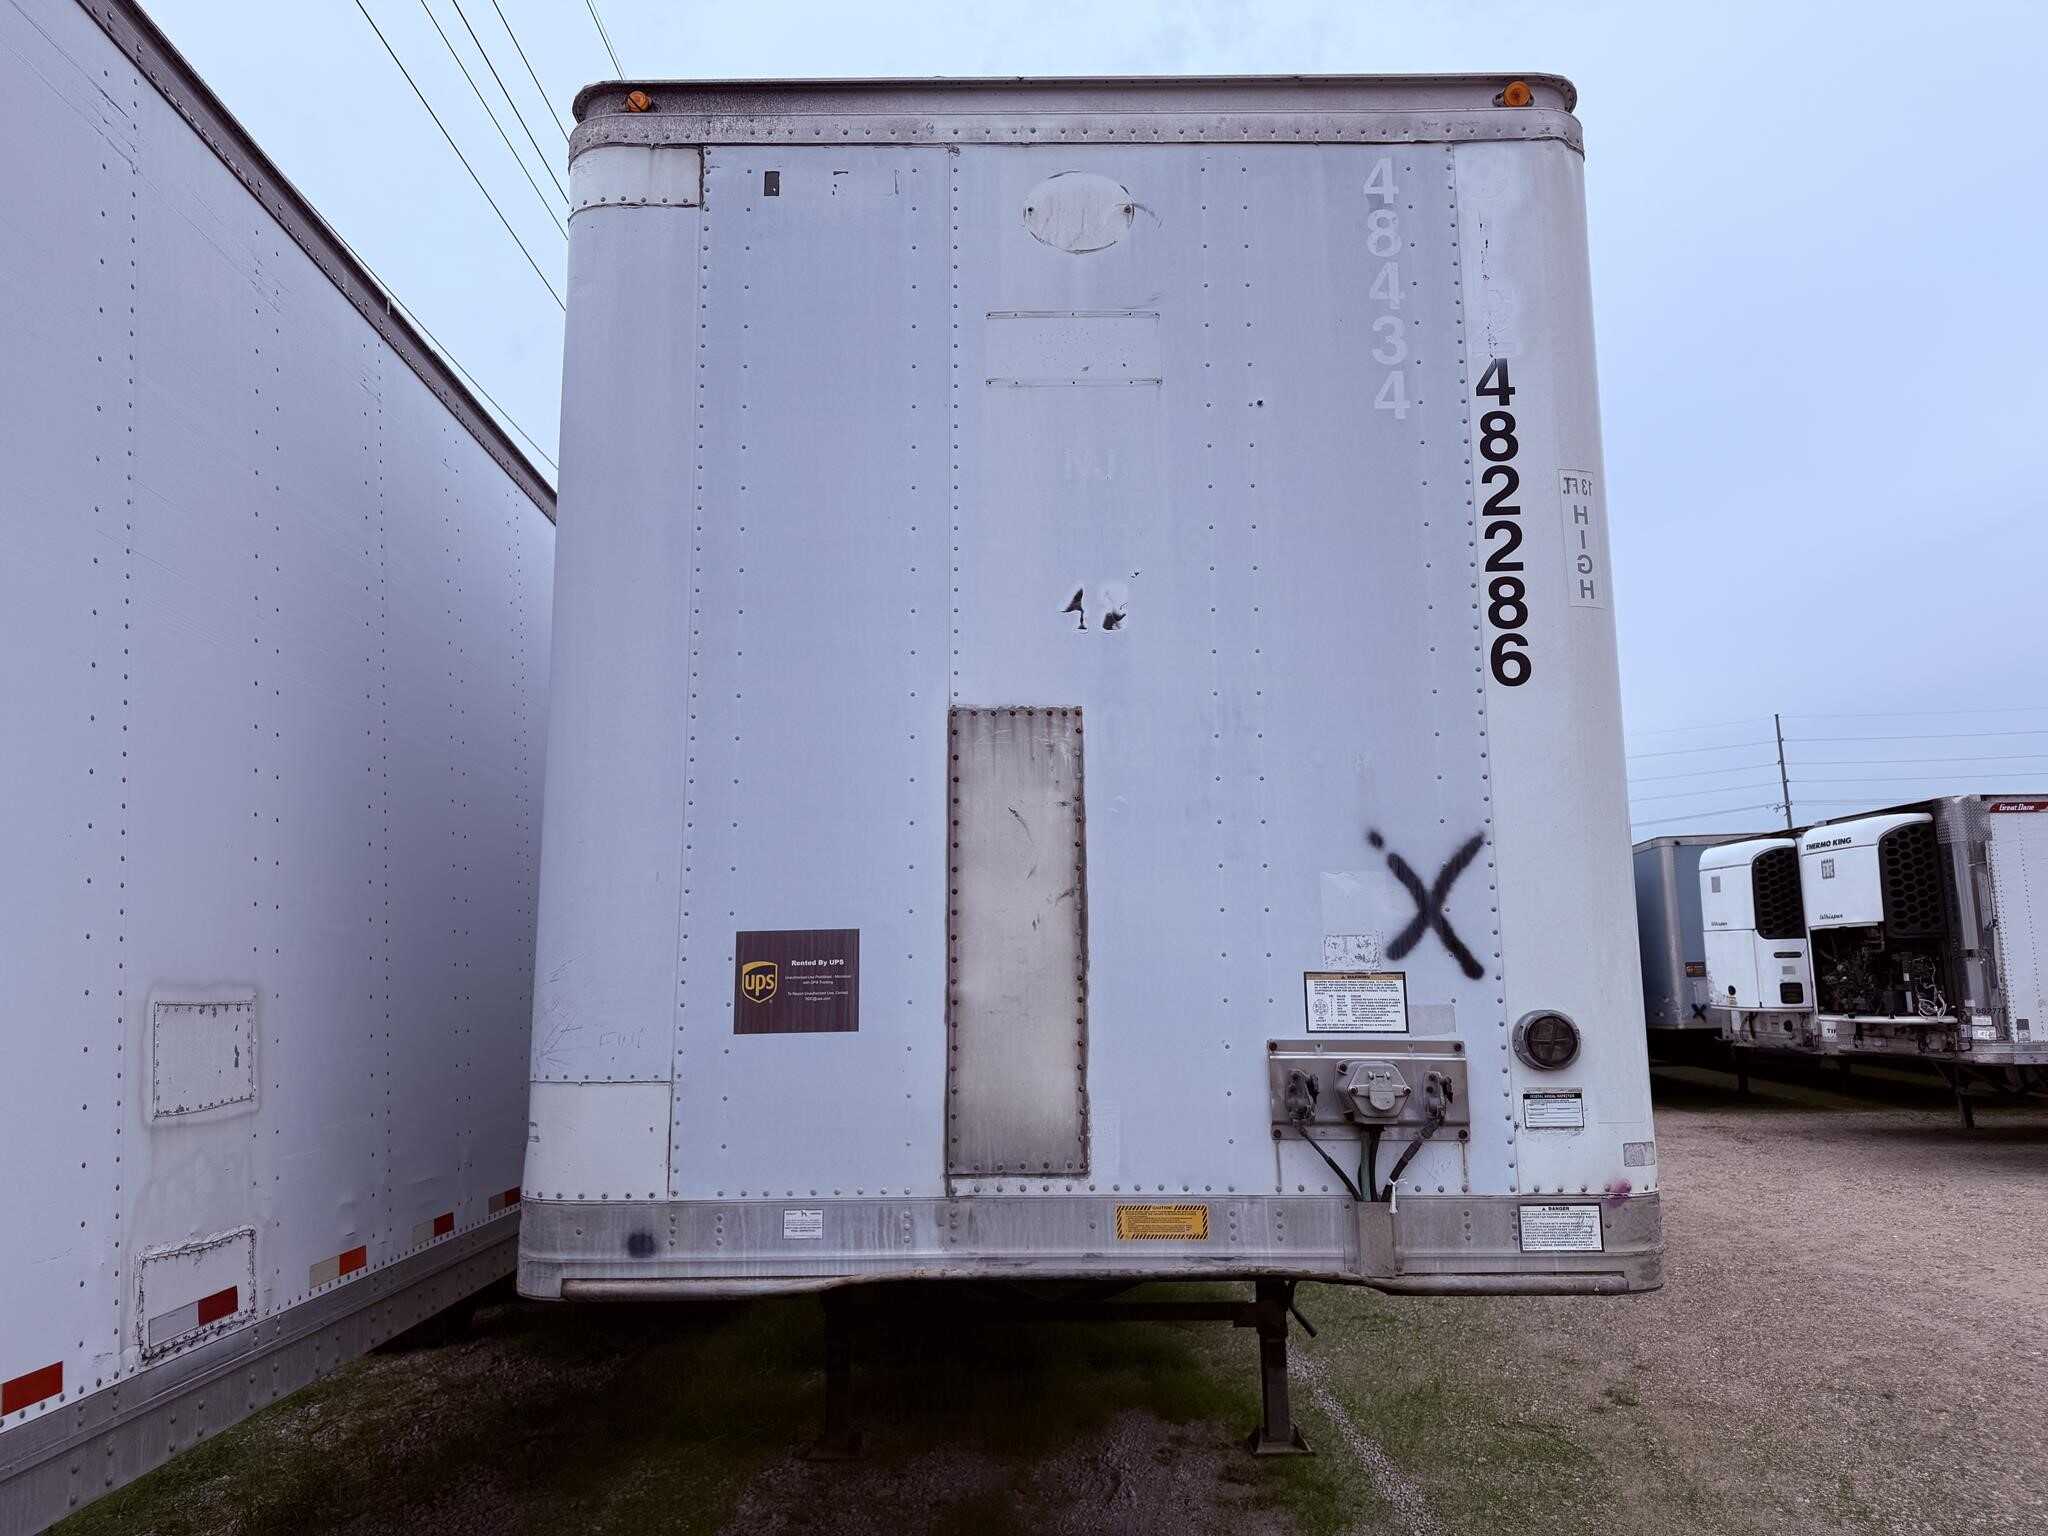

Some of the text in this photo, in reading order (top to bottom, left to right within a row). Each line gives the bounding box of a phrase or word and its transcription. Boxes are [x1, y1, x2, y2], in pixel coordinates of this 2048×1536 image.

[1362, 157, 1411, 421] 48434
[1475, 358, 1531, 688] 482286
[1367, 830, 1485, 980] X
[1806, 837, 1852, 851] THERMO KING
[745, 973, 775, 997] ups
